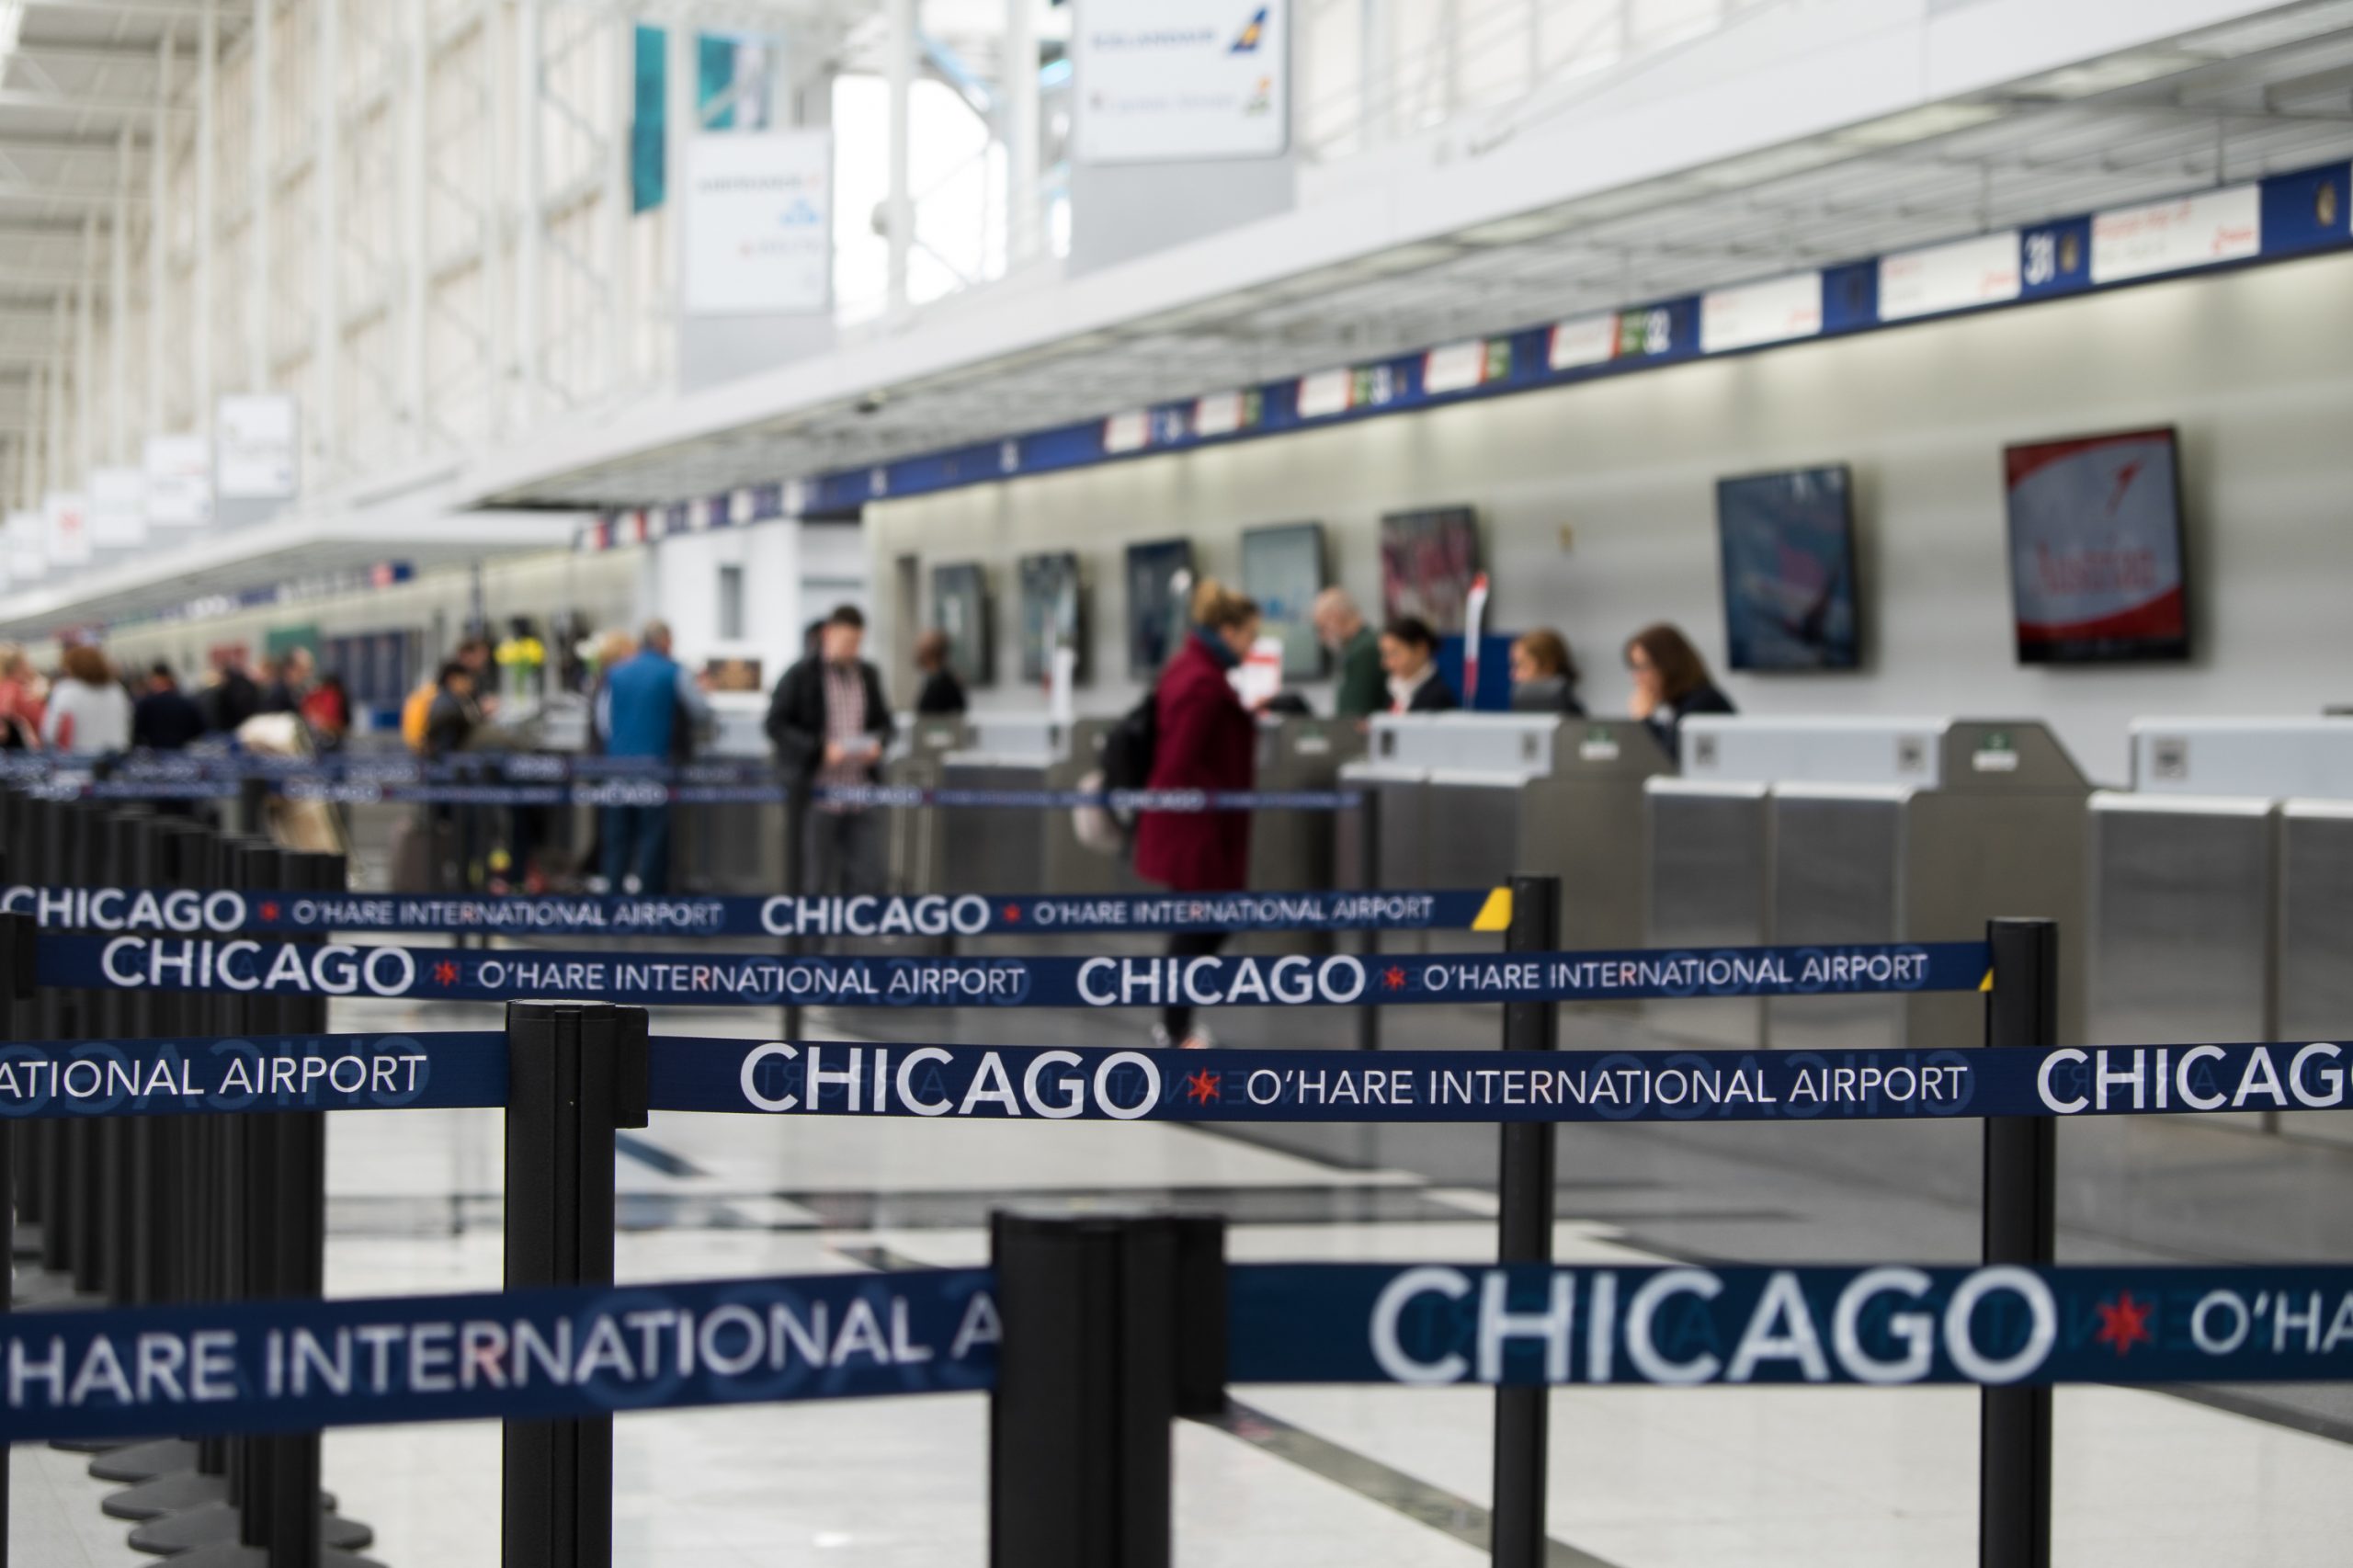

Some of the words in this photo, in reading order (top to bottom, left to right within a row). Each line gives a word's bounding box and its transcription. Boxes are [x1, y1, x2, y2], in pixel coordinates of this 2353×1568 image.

[2, 885, 247, 932] CHICAGO
[291, 899, 394, 926] O'HARE
[400, 900, 608, 926] INTERNATIONAL
[613, 902, 723, 928] AIRPORT
[761, 894, 991, 936] CHICAGO
[1033, 900, 1127, 926] O'HARE
[1133, 897, 1328, 925] INTERNATIONAL
[1332, 896, 1436, 921] AIRPORT
[101, 936, 415, 996] CHICAGO
[478, 960, 605, 990] O'HARE
[616, 964, 880, 994] INTERNATIONAL
[888, 967, 1027, 995] AIRPORT
[1076, 954, 1367, 1006] CHICAGO
[1423, 962, 1540, 991] O'HARE
[1551, 957, 1794, 989] INTERNATIONAL
[1800, 952, 1928, 983] AIRPORT
[219, 1054, 426, 1095] AIRPORT
[740, 1041, 1162, 1120] CHICAGO
[1246, 1068, 1413, 1105] O'HARE
[1430, 1068, 1777, 1105] INTERNATIONAL
[1789, 1065, 1968, 1102] AIRPORT
[2037, 1042, 2353, 1114] CHICAG
[0, 1329, 238, 1407] HARE
[266, 1295, 933, 1397] INTERNATIONAL
[1370, 1266, 2057, 1386] CHICAGO
